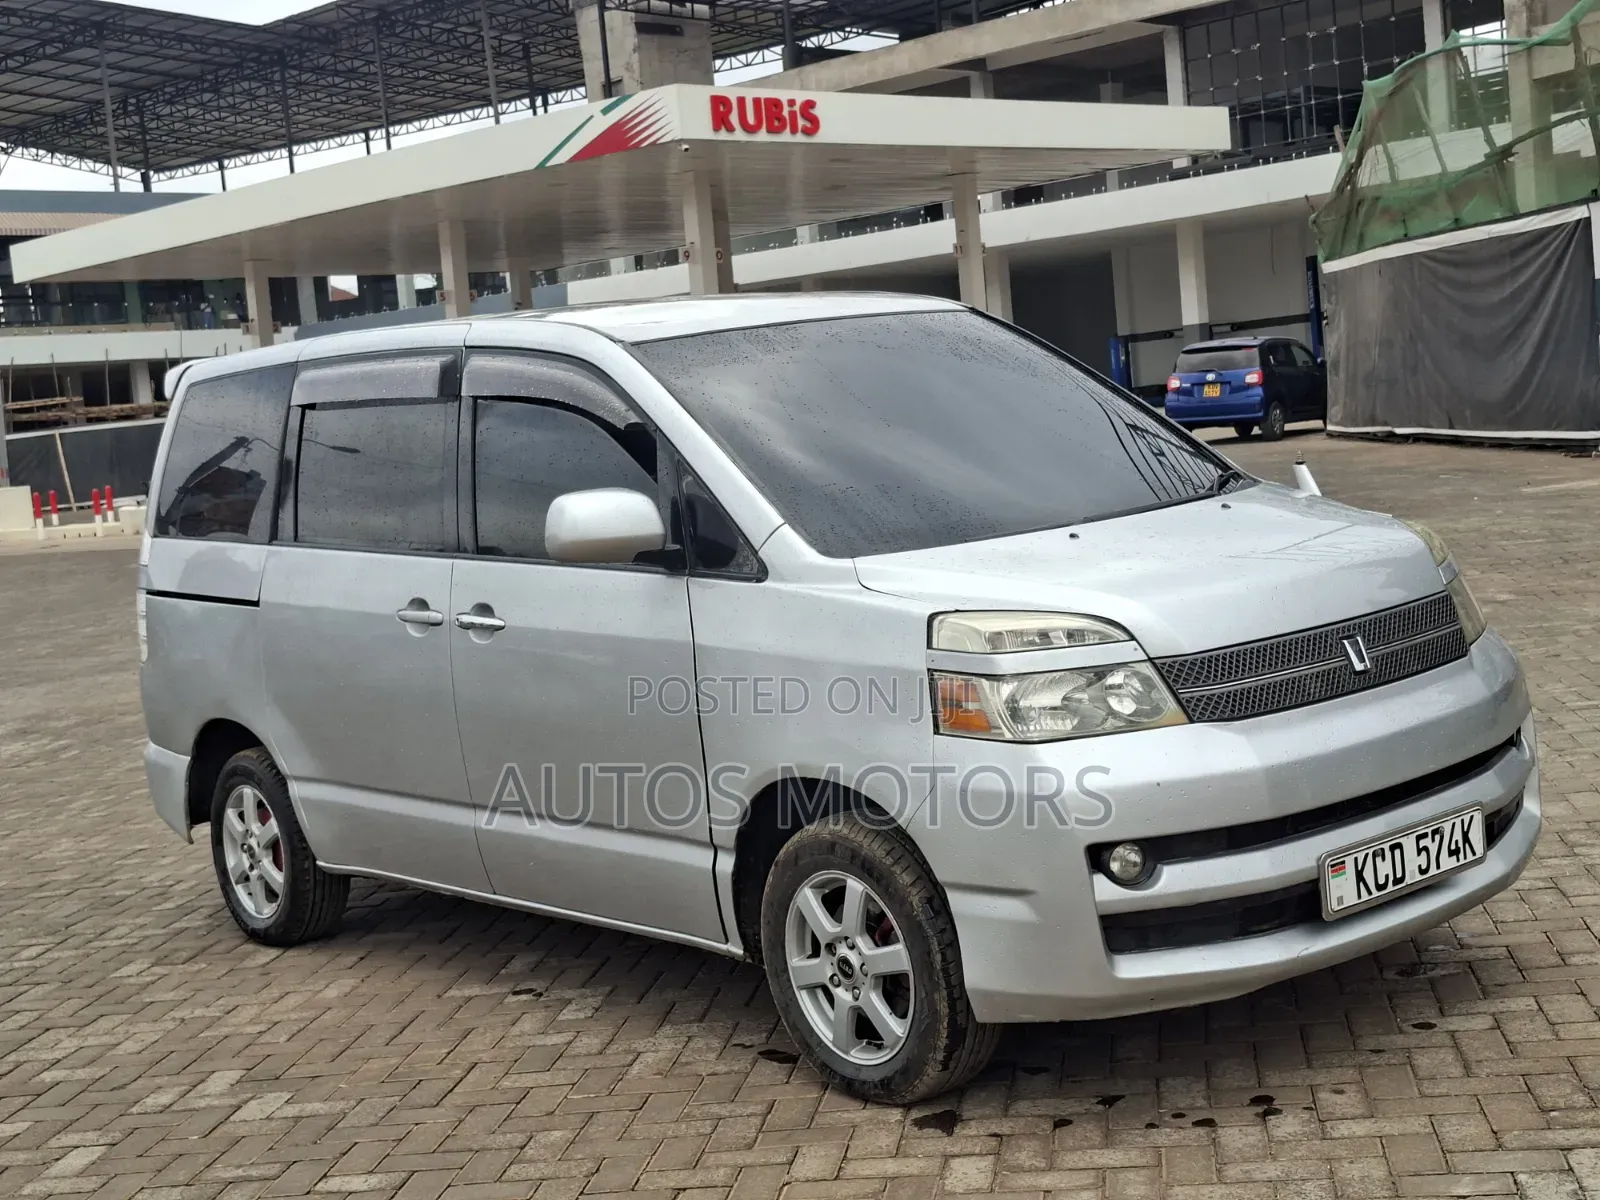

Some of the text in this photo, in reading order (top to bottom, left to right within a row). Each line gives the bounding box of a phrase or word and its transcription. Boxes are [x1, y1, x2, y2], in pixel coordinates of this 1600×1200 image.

[710, 95, 820, 136] RUBiS
[683, 250, 690, 261] 9
[440, 291, 446, 301] 5
[1354, 814, 1477, 900] KCD 574K
